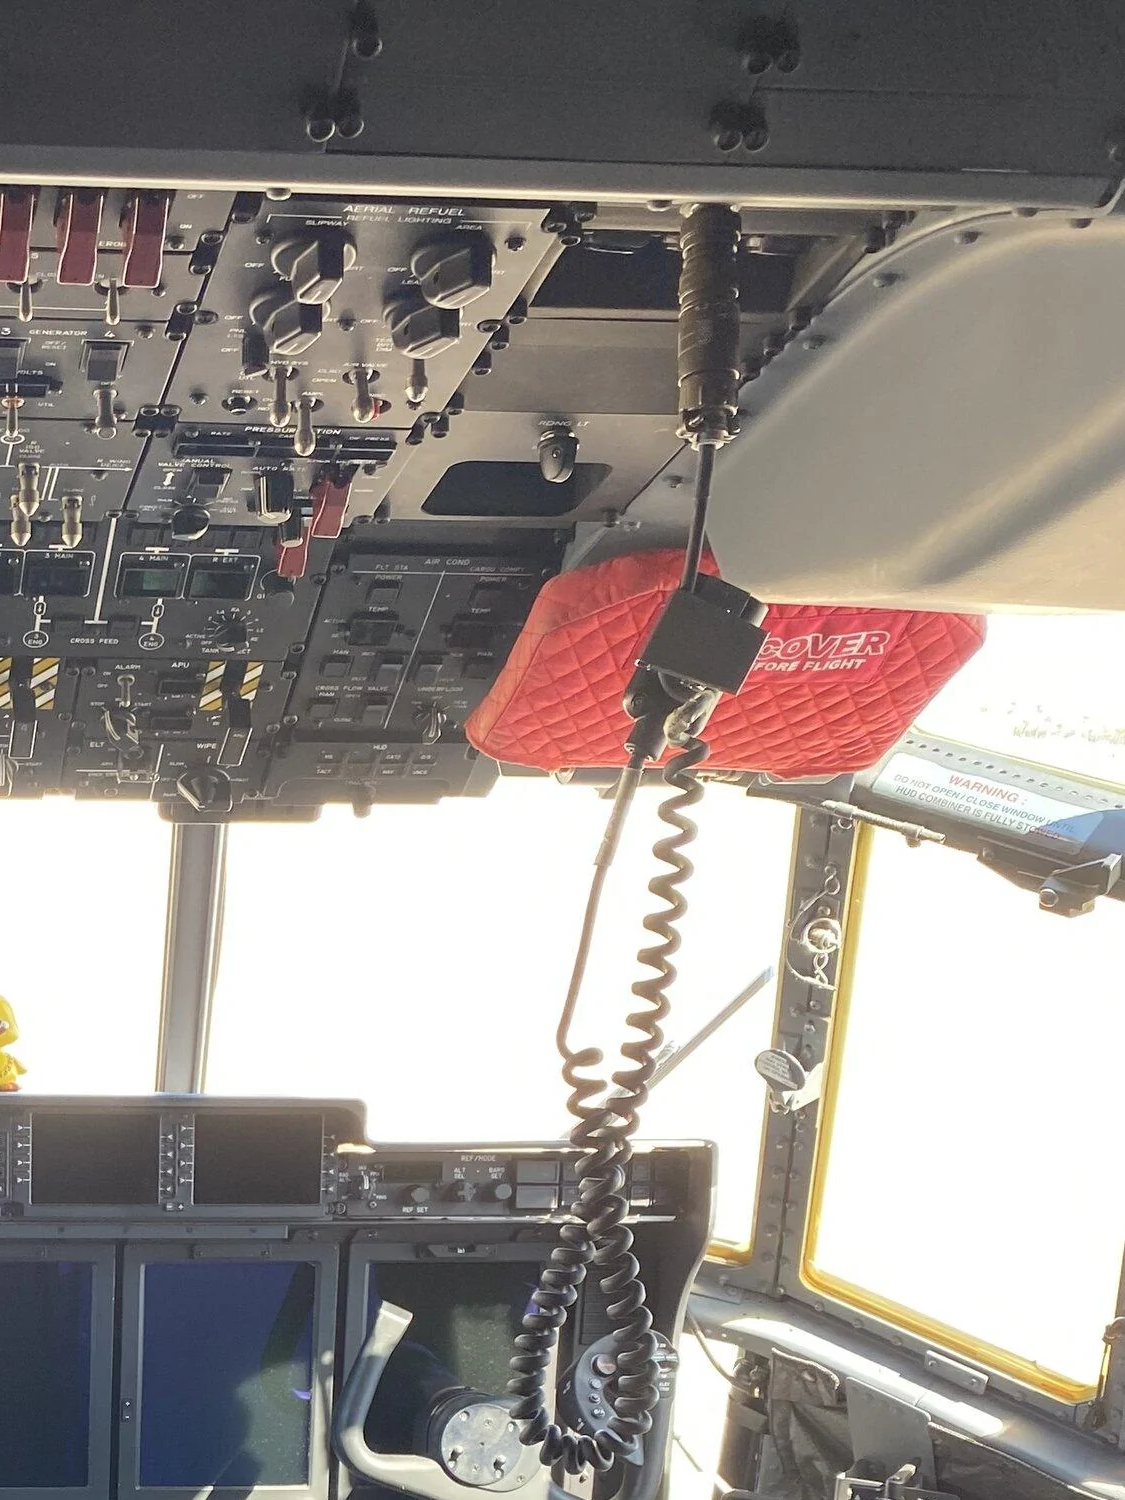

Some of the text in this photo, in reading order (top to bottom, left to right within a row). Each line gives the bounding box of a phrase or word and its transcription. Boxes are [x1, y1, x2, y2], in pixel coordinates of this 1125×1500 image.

[343, 205, 465, 216] AERIAL REFUEL
[305, 219, 349, 227] SLIPWAY
[346, 215, 453, 225] REFUEL LIGHTING
[28, 329, 88, 337] GENERATOR
[244, 426, 342, 436] PRESSURTION
[424, 558, 471, 566] AIR COND
[70, 637, 95, 645] CROSS
[756, 630, 891, 661] COVER
[171, 661, 191, 669] APU
[752, 658, 867, 673] FORE FLIGHT
[367, 685, 389, 693] VALVE
[949, 774, 1020, 804] WARNING
[893, 773, 910, 785] DO
[911, 777, 930, 790] NOT
[1001, 803, 1046, 824] WINDOW
[1046, 817, 1076, 833] UNTIL
[895, 785, 918, 798] HUD
[919, 791, 970, 815] COMBINER
[972, 808, 982, 819] IS
[983, 811, 1017, 829] FULLY
